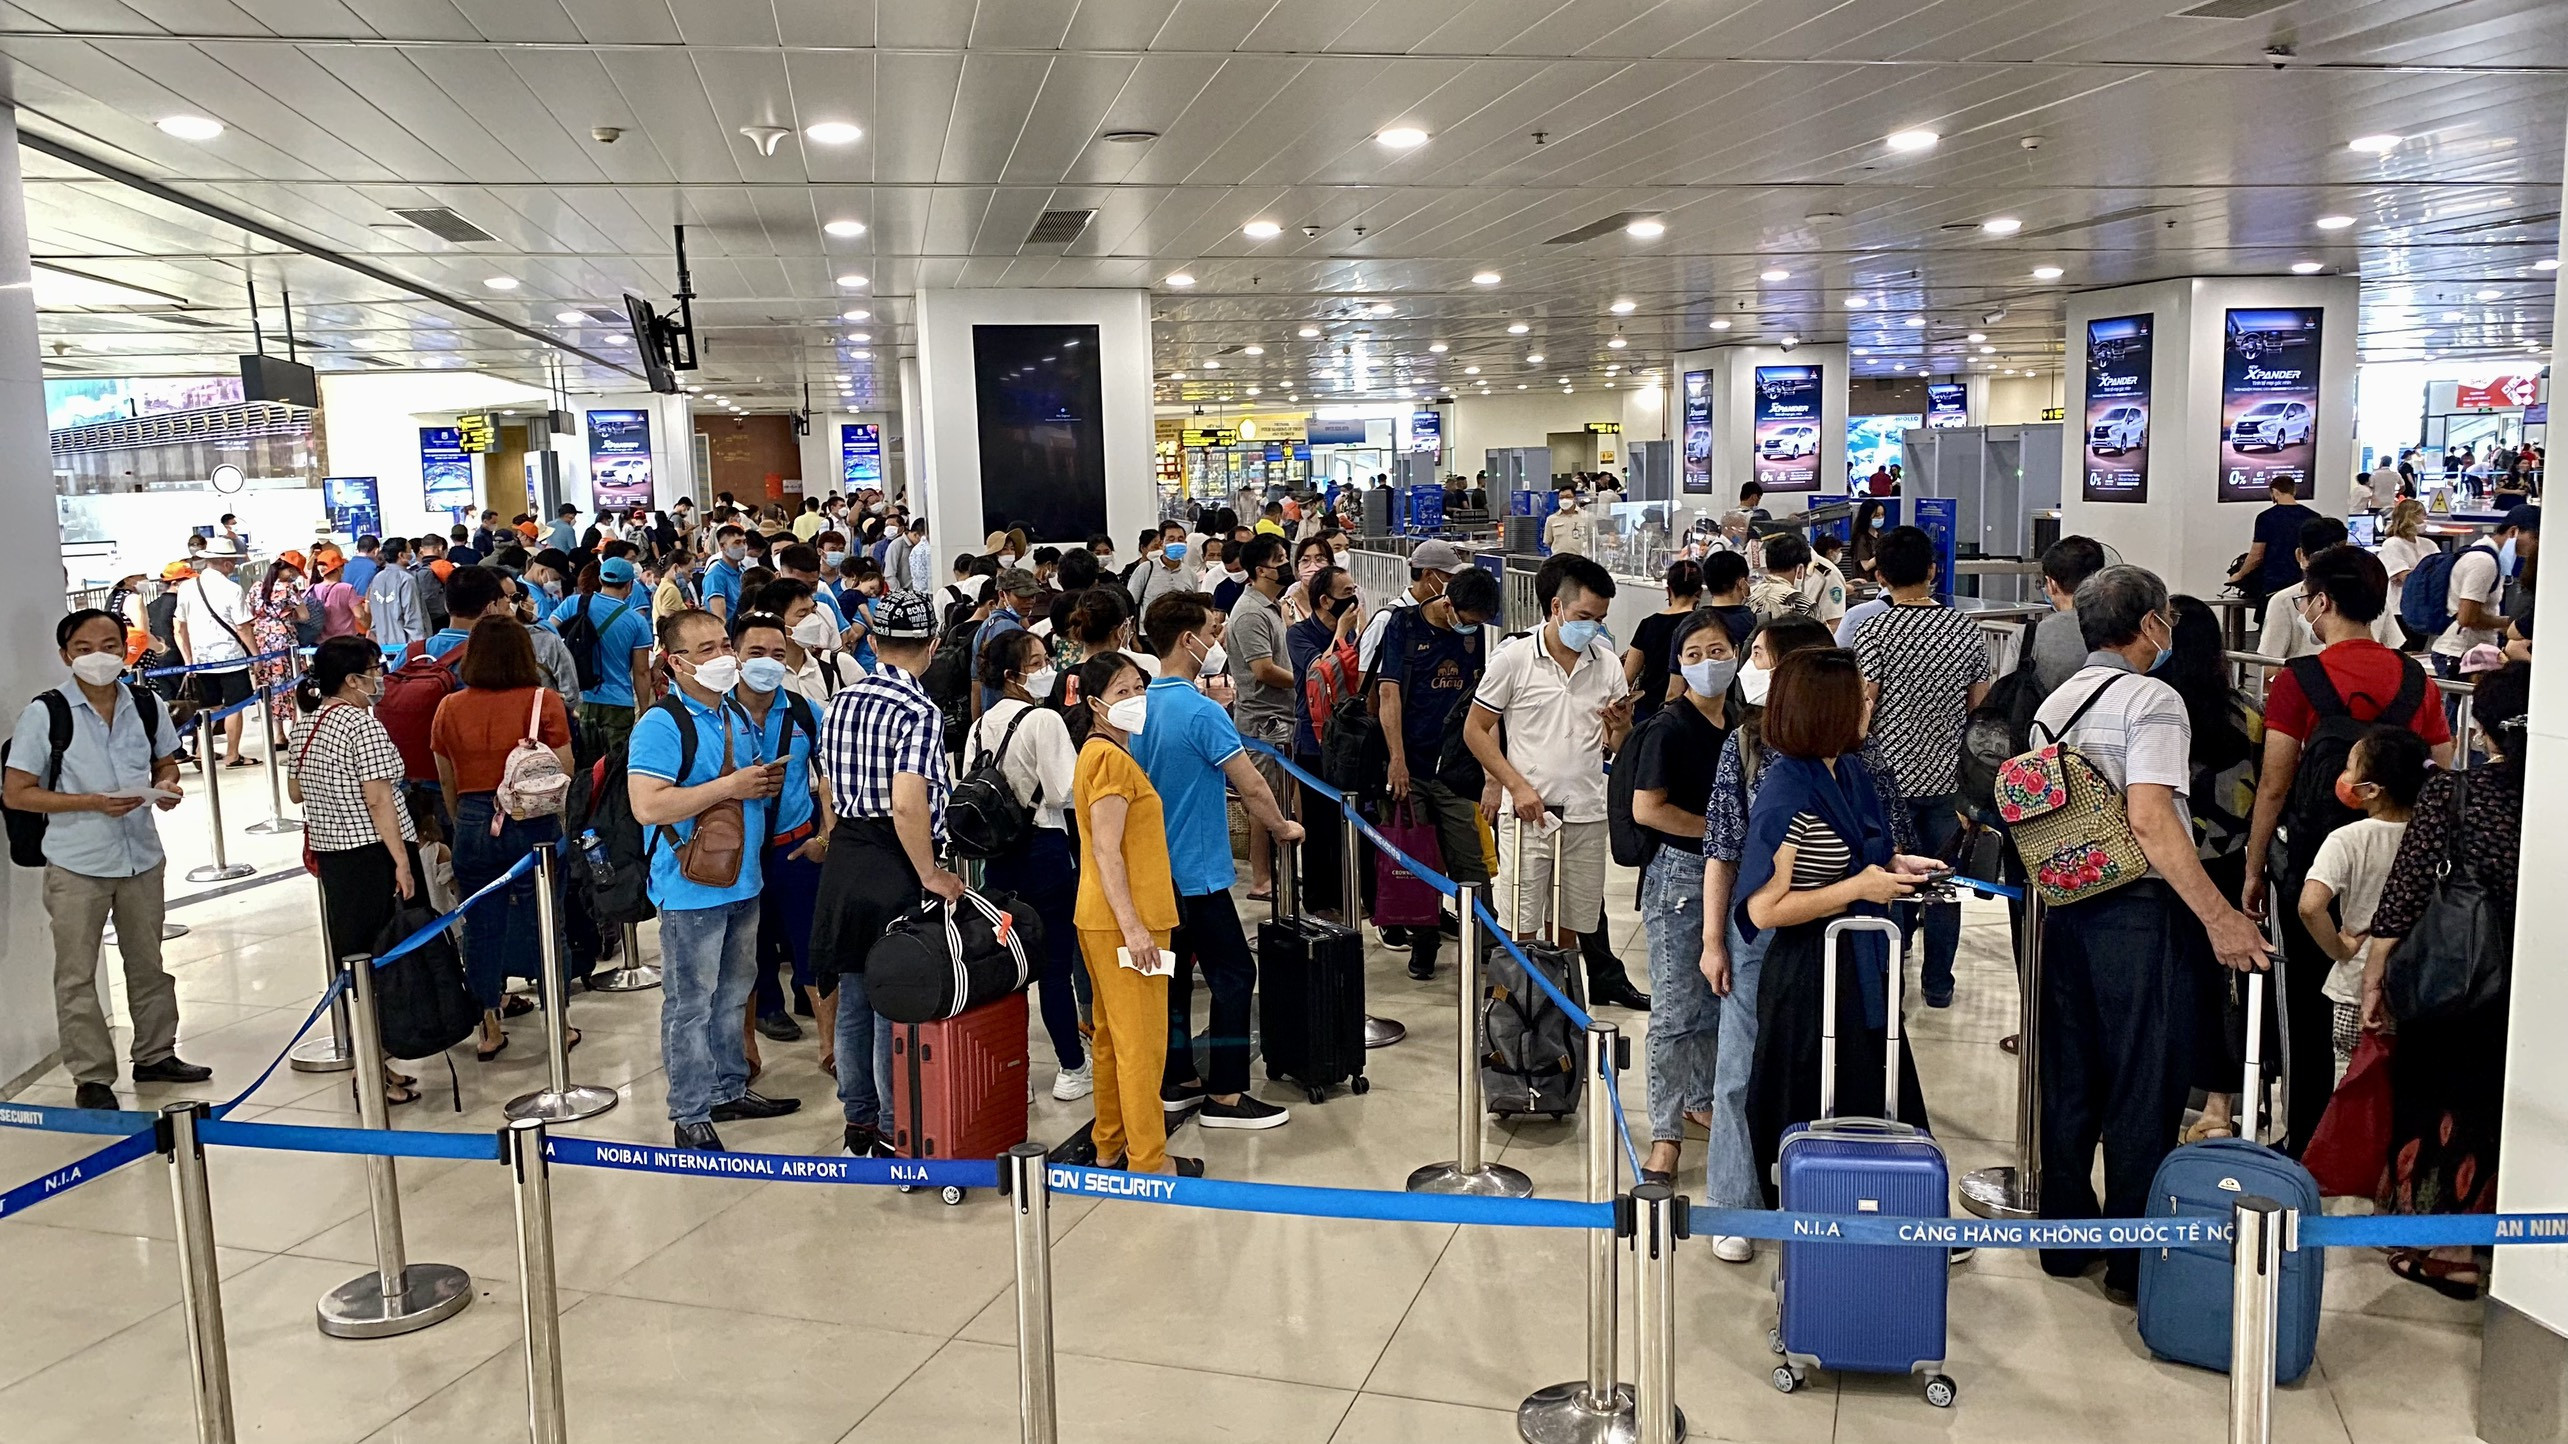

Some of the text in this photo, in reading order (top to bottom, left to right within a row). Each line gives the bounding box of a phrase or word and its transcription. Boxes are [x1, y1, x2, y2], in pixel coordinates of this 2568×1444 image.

[2098, 376, 2138, 387] XPANDER
[2243, 369, 2301, 380] XPANDER
[2229, 471, 2246, 485] 0%
[0, 1107, 44, 1126] SECURITY
[596, 1147, 848, 1178] NOIBAI INTERNATIONAL AIRPORT
[45, 1166, 82, 1192] N.I.A
[890, 1165, 929, 1181] N.I.A
[1084, 1173, 1176, 1199] SECURITY
[1794, 1219, 1841, 1237] N.I.A
[1899, 1219, 2234, 1244] CẢNG HÀNG KHÔNG QUỐC TẾ NỘ
[2495, 1219, 2568, 1237] AN NIN
